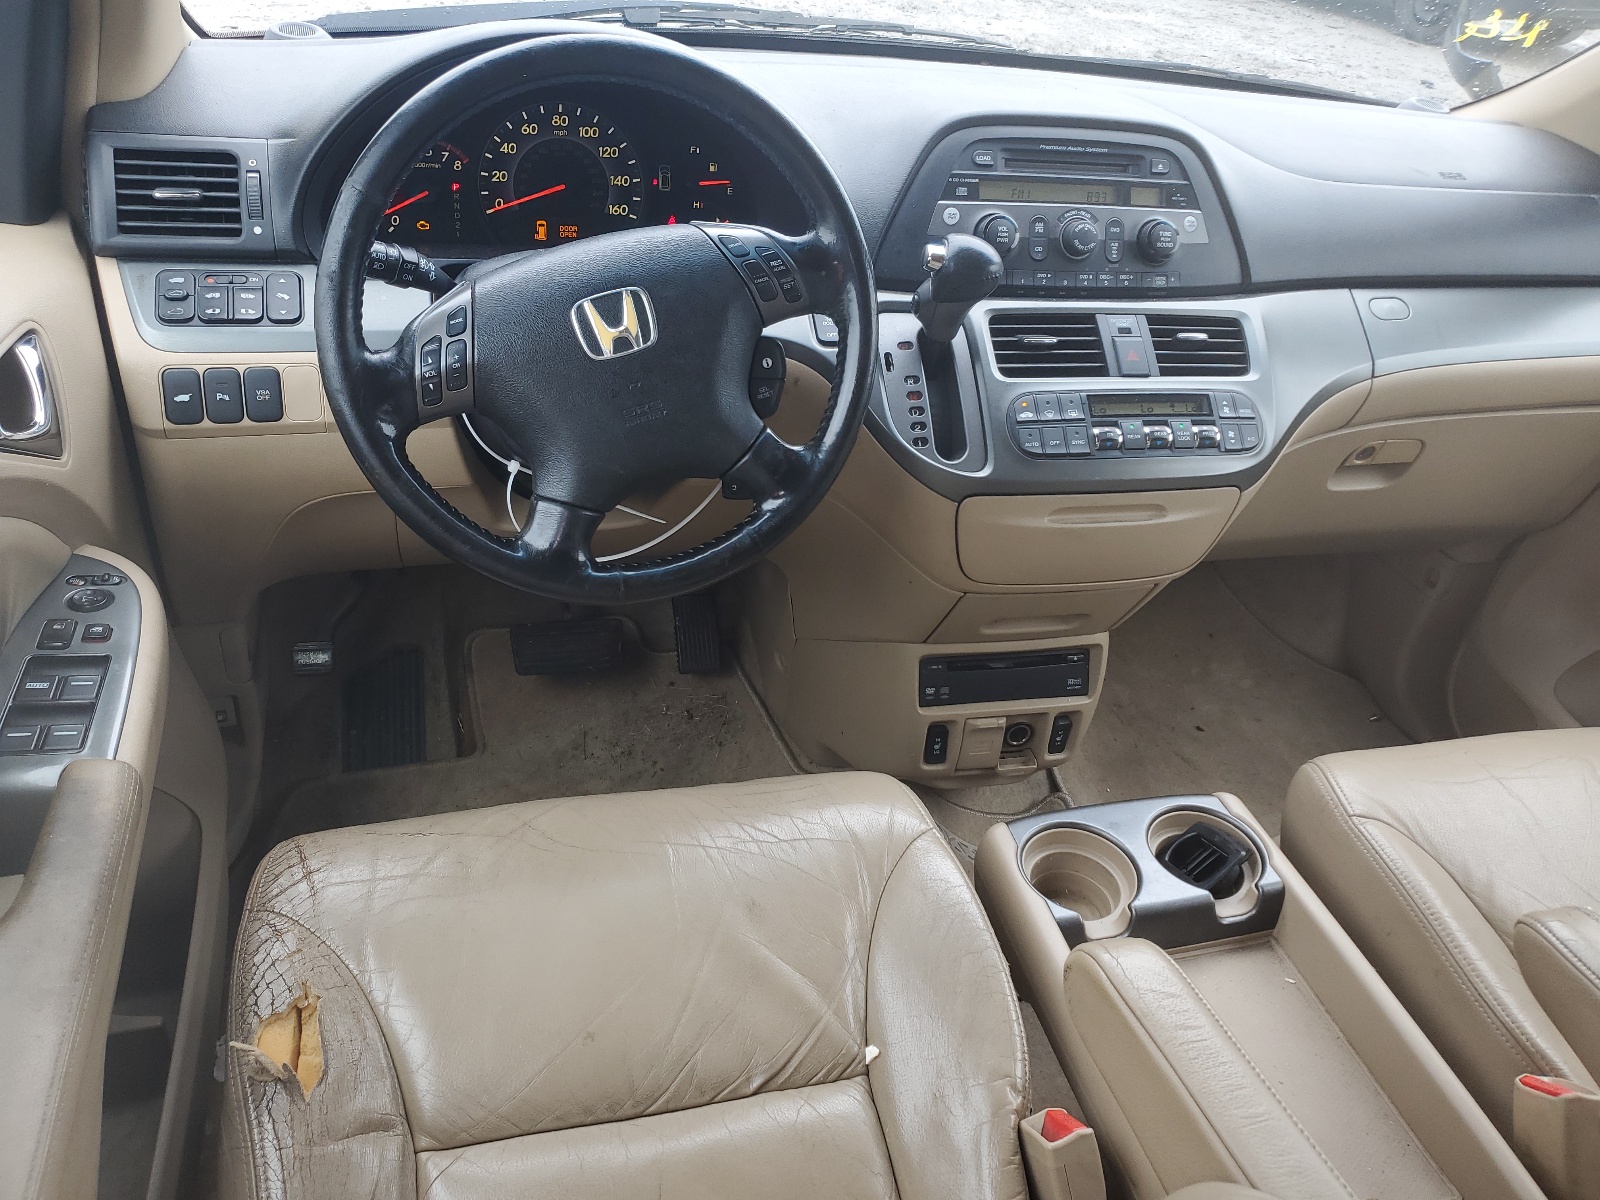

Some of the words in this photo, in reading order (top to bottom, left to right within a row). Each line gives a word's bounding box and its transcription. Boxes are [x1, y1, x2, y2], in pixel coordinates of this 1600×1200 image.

[552, 115, 569, 126] 80
[521, 124, 538, 135] 60
[553, 129, 568, 137] mph
[579, 126, 599, 138] 100
[500, 143, 517, 154] 40
[598, 147, 619, 158] 120
[441, 151, 450, 162] 7
[453, 160, 462, 171] 8
[491, 171, 508, 182] 20
[610, 176, 630, 187] 140
[453, 183, 460, 191] P
[727, 187, 734, 195] E
[495, 198, 504, 209] 0
[693, 201, 700, 209] H
[608, 204, 628, 216] 160
[391, 215, 400, 226] 0
[454, 212, 461, 220] D
[371, 252, 387, 260] AUTO
[403, 262, 417, 271] OFF
[402, 273, 414, 282] ON
[783, 281, 795, 290] SET
[449, 317, 464, 325] MODE
[907, 378, 914, 386] R
[912, 408, 919, 416] D
[914, 423, 921, 432] 2
[917, 437, 921, 446] 1
